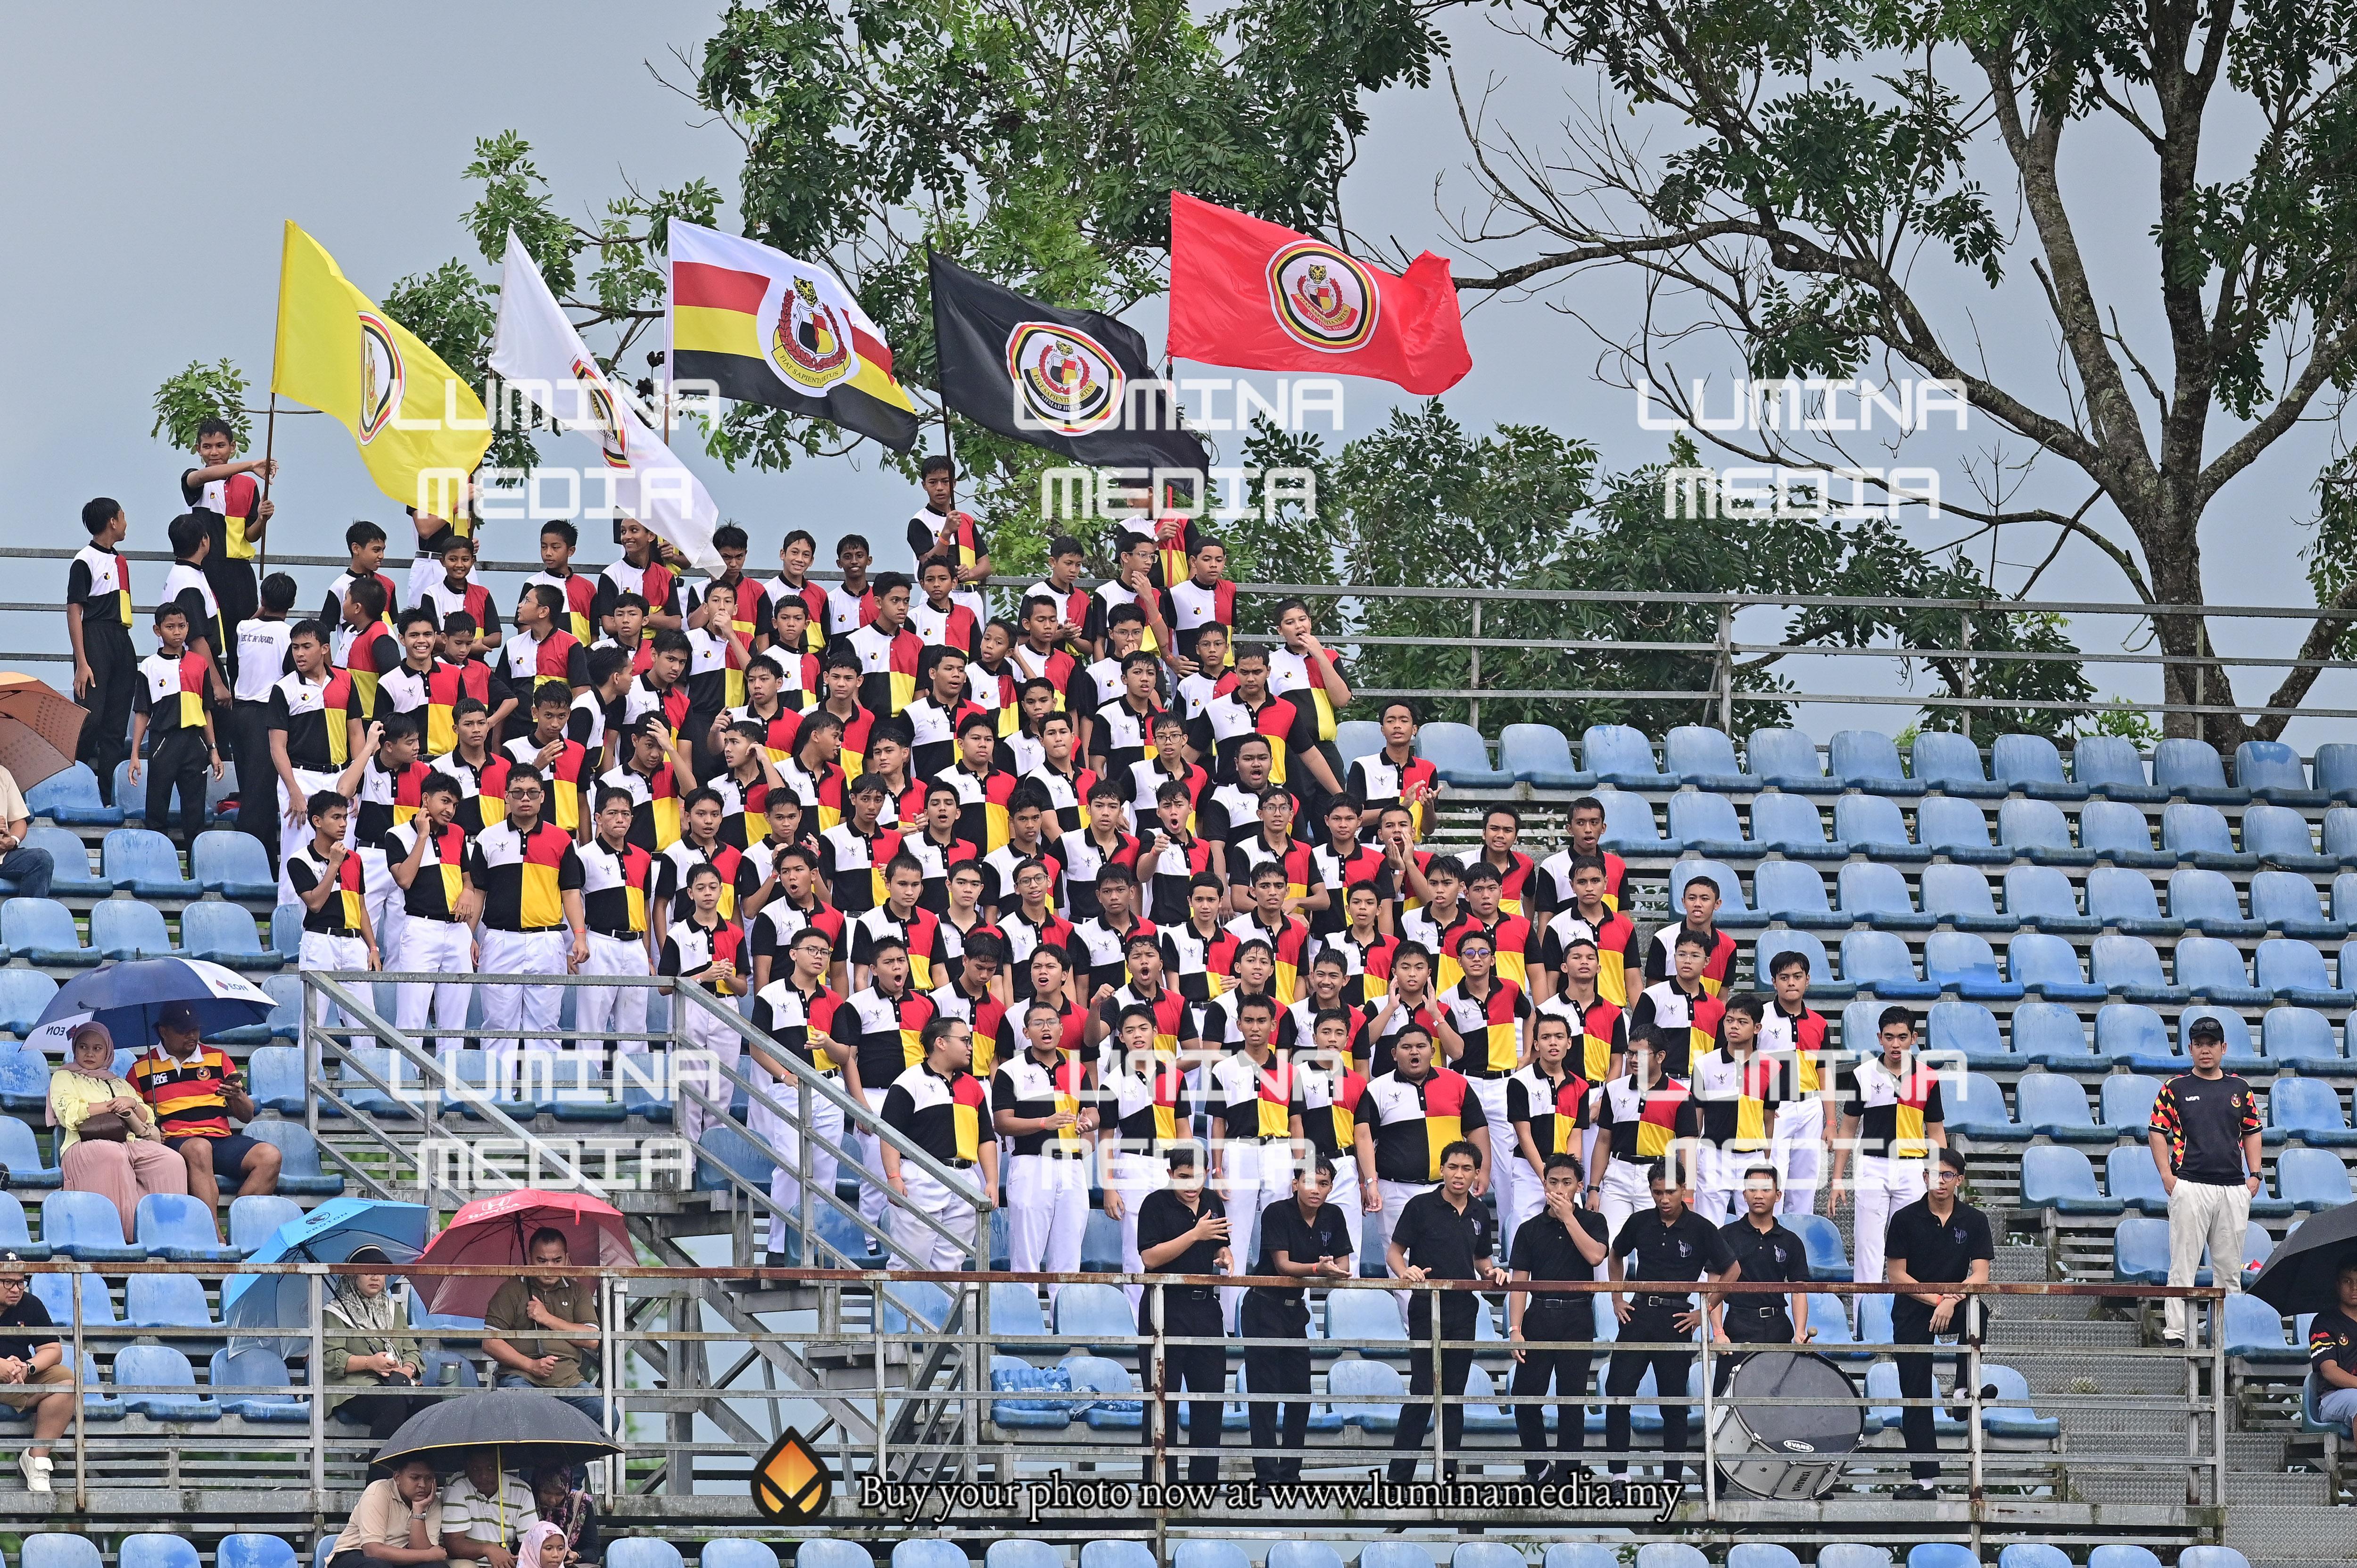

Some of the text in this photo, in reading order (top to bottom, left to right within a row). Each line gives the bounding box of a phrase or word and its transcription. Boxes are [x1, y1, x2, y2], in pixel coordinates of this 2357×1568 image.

[1336, 309, 1348, 322] VIRTUS
[780, 355, 794, 371] FIAT
[1034, 374, 1045, 389] FIAT
[1039, 395, 1083, 411] AHMAD HOUSE
[228, 983, 249, 991] EON
[468, 1203, 521, 1219] HONDA
[306, 1212, 347, 1233] PROTON
[1791, 1470, 1812, 1492] YAMAHA
